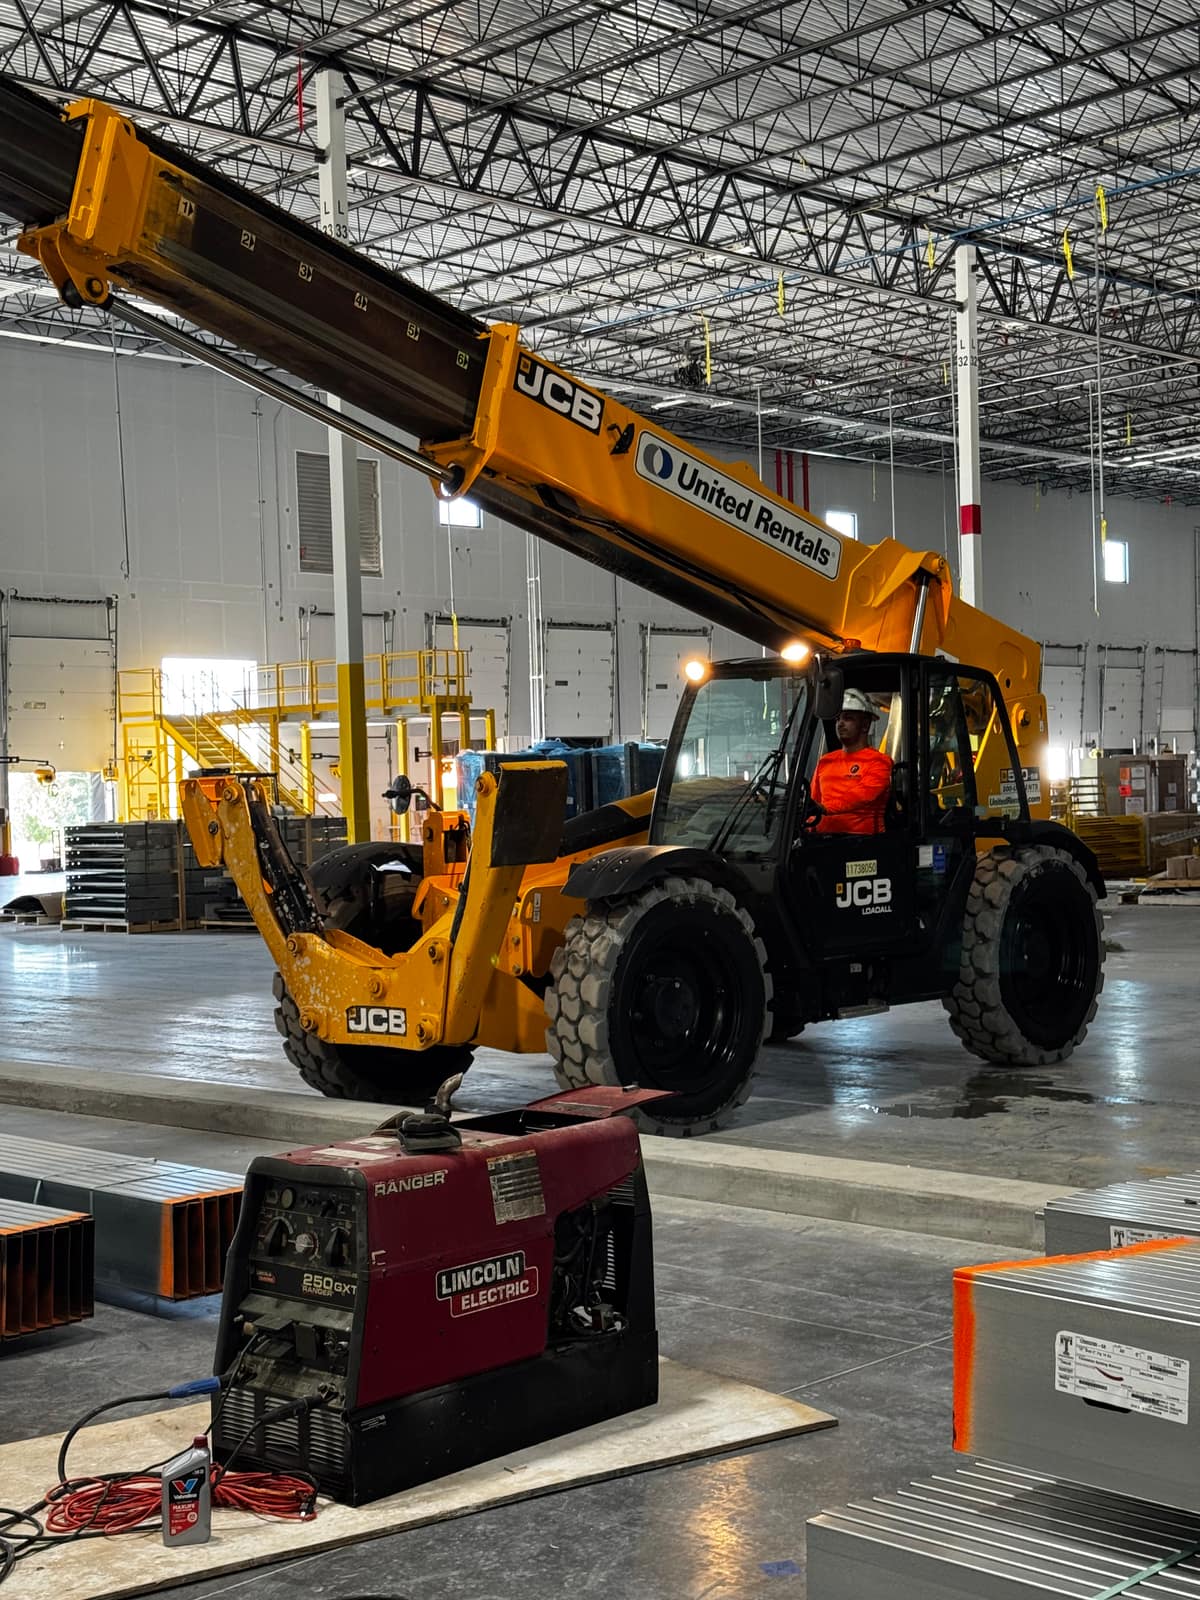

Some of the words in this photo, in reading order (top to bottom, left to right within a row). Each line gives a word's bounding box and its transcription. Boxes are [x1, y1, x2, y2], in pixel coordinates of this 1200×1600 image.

[323, 201, 330, 215] L
[337, 199, 345, 215] L
[335, 223, 348, 239] 33
[958, 355, 969, 367] 32
[517, 364, 602, 430] JCB
[677, 462, 754, 523] United
[754, 505, 831, 567] Rentals
[846, 861, 876, 876] 11738050
[836, 878, 892, 908] JCB
[861, 904, 893, 915] LOADALL
[349, 1007, 406, 1034] JCB
[374, 1171, 446, 1198] RANGER
[302, 1272, 333, 1290] 250
[333, 1281, 357, 1296] GXT
[441, 1256, 521, 1295] LINCOLN
[461, 1279, 530, 1311] ELECTRIC
